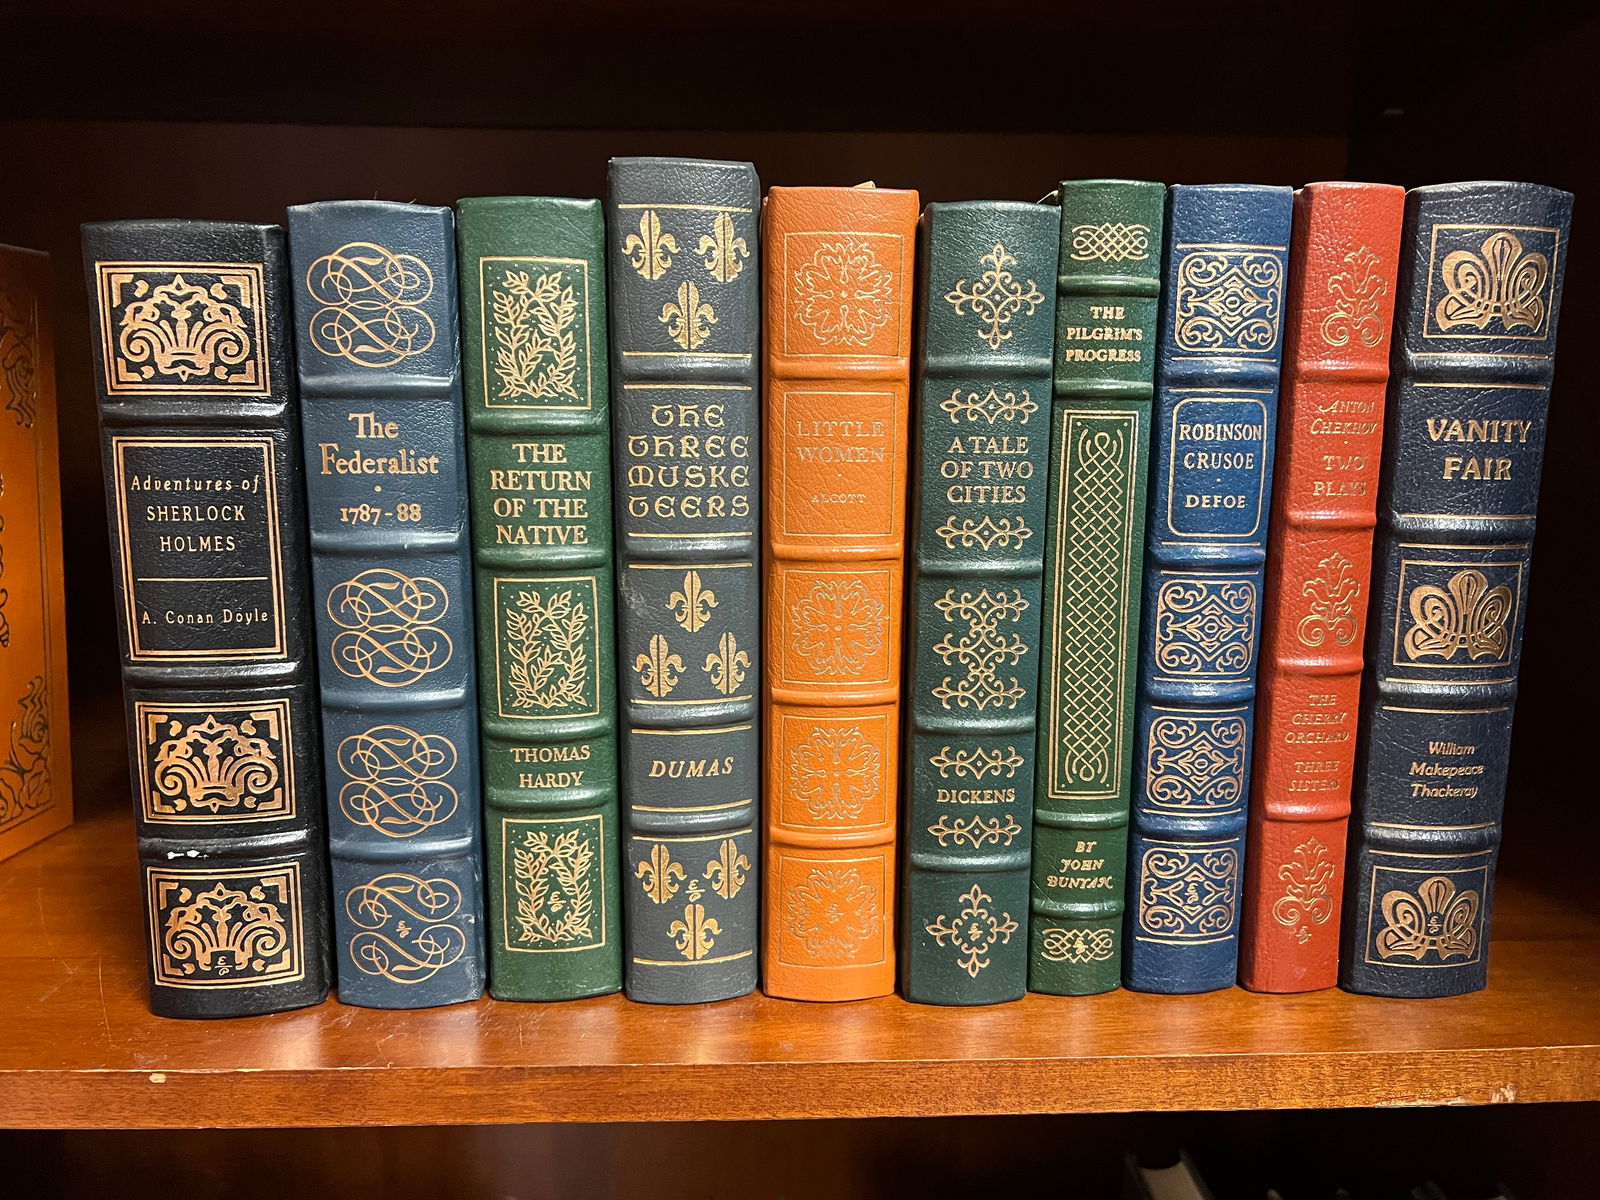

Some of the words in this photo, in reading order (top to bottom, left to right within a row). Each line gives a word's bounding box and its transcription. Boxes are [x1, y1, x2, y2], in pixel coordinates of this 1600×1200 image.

[1090, 306, 1125, 320] THE
[1066, 327, 1143, 341] PILGRIM'S
[1065, 349, 1142, 362] PROGRESS
[348, 411, 399, 438] The
[796, 420, 885, 437] LITTLE
[1178, 423, 1263, 441] ROBINSON
[1426, 418, 1532, 442] VANITY
[511, 443, 568, 464] THE
[947, 436, 966, 454] A
[968, 436, 1029, 454] TALE
[318, 442, 440, 475] Federalist
[796, 446, 885, 464] WOMEN
[1183, 452, 1254, 470] CRUSOE
[1322, 455, 1365, 471] TWO
[628, 465, 750, 488] MUSKE
[940, 460, 974, 479] OF
[978, 460, 1034, 479] TWO
[1442, 456, 1512, 480] FAIR
[131, 475, 232, 491] Adventures
[241, 474, 260, 494] of
[490, 469, 593, 491] RETURN
[1312, 481, 1367, 497] PLAYS
[946, 485, 1026, 503] CITIES
[1184, 494, 1246, 509] DEFOE
[146, 505, 246, 522] SHERLOCK
[493, 497, 526, 518] OF
[532, 498, 589, 518] THE
[628, 495, 750, 518] TEERS
[495, 524, 589, 545] NATIVE
[159, 536, 236, 553] HOLMES
[141, 611, 157, 625] A.
[165, 611, 215, 624] Conan
[222, 608, 269, 625] Doyle
[509, 744, 591, 763] THOMAS
[1428, 741, 1475, 756] William
[648, 756, 734, 778] DUMAS
[1408, 761, 1484, 779] Makepeace
[518, 770, 584, 789] HARDY
[936, 788, 1016, 804] DICKENS
[1410, 783, 1478, 799] Thackeray
[1075, 841, 1097, 853] BY
[1059, 858, 1105, 873] JOHN
[1046, 874, 1114, 890] BUNYAN
